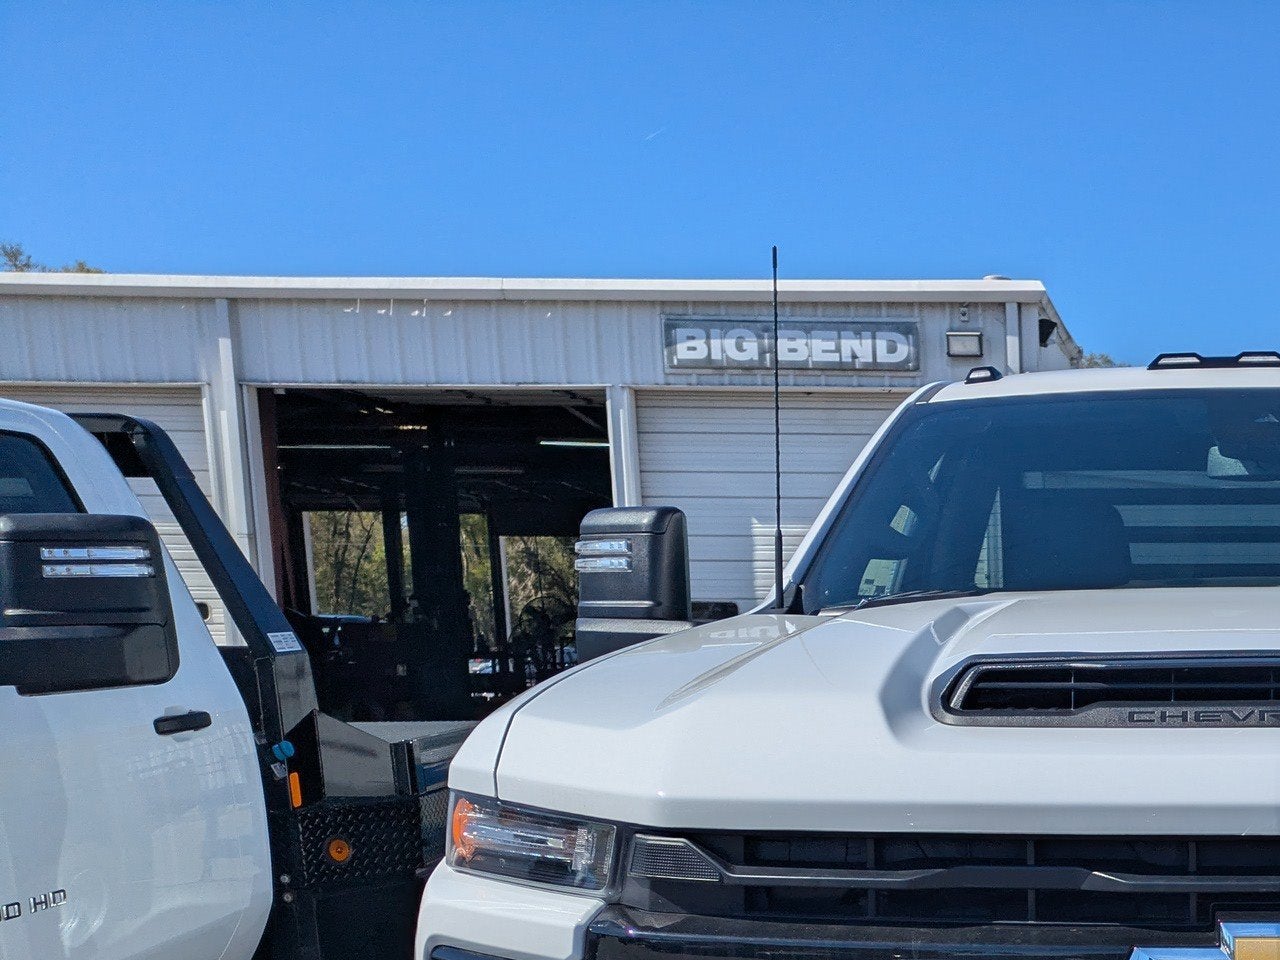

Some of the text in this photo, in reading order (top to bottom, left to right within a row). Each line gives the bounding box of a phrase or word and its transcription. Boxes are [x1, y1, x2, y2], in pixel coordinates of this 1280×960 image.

[675, 328, 910, 363] BIG BEND
[29, 889, 67, 914] HD
